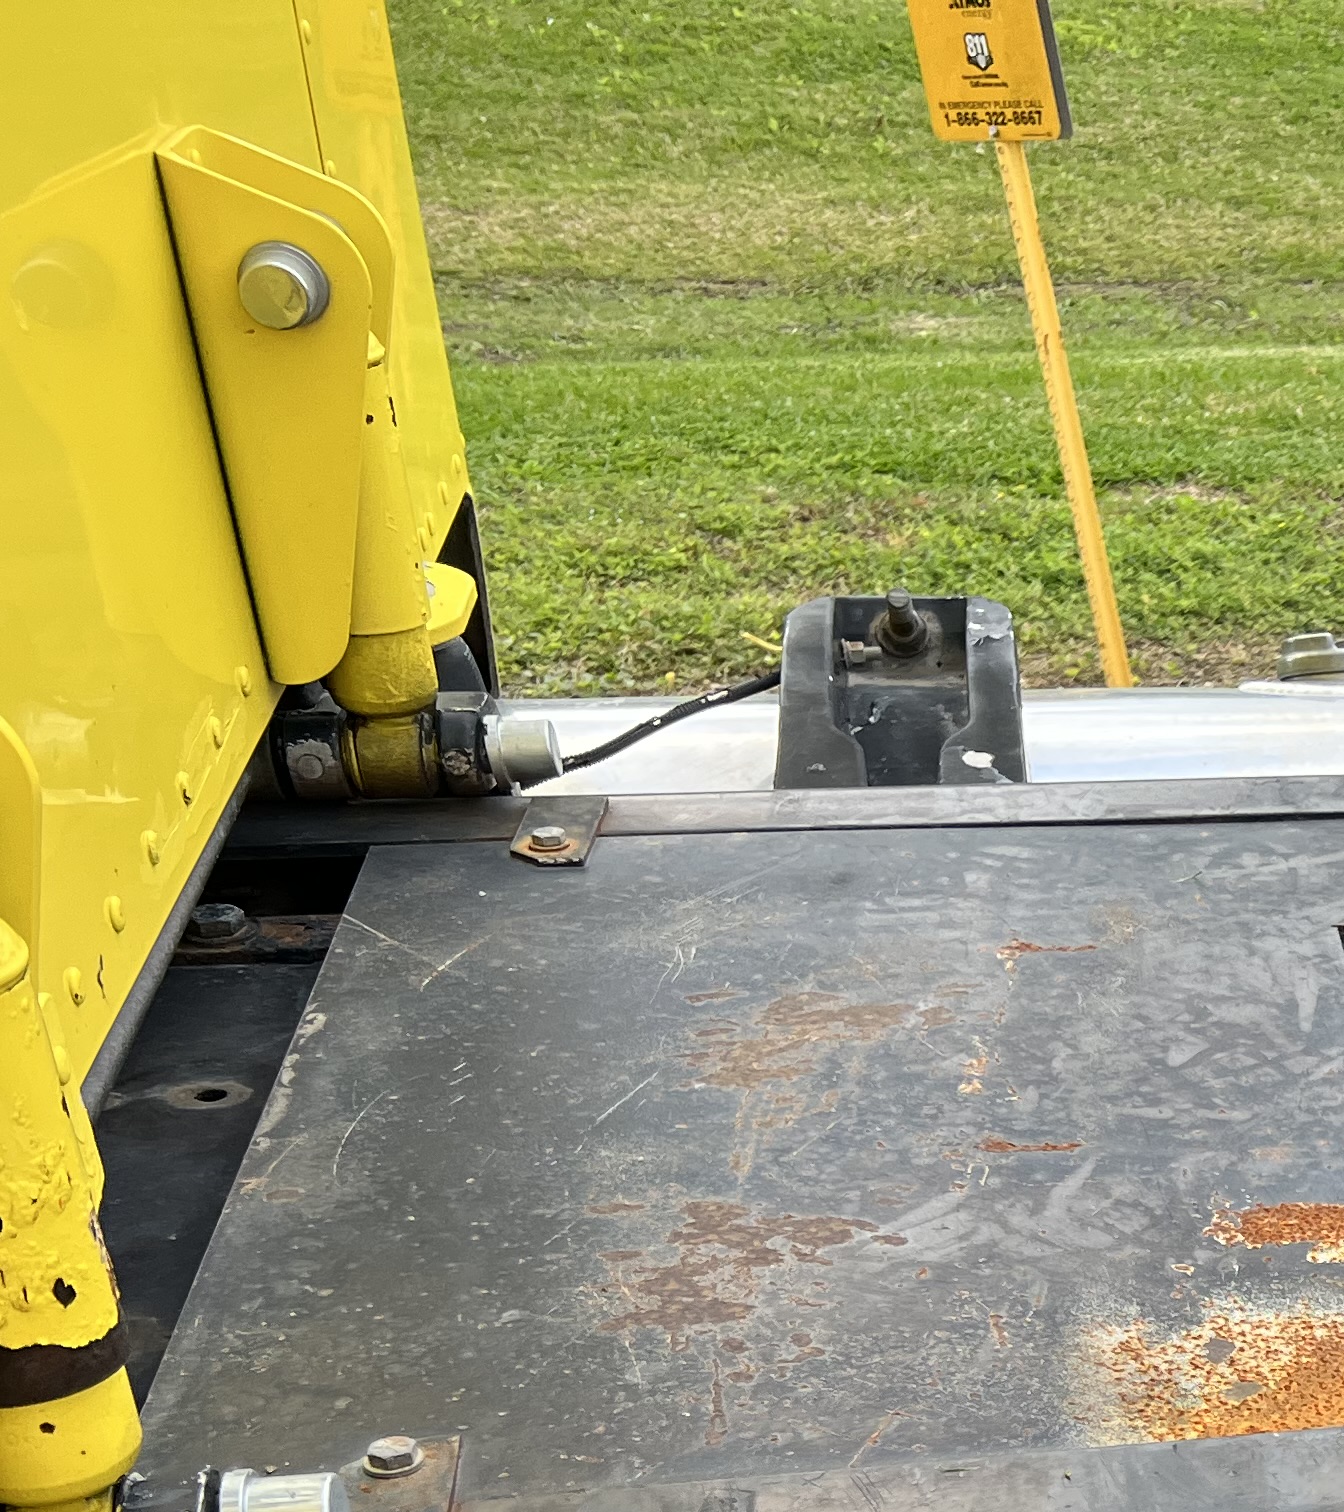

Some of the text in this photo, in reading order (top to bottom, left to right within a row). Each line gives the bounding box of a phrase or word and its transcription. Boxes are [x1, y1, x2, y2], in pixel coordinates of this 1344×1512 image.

[964, 33, 989, 57] 811
[1024, 100, 1044, 109] CALL
[944, 110, 1042, 127] 1-866-322-8667
